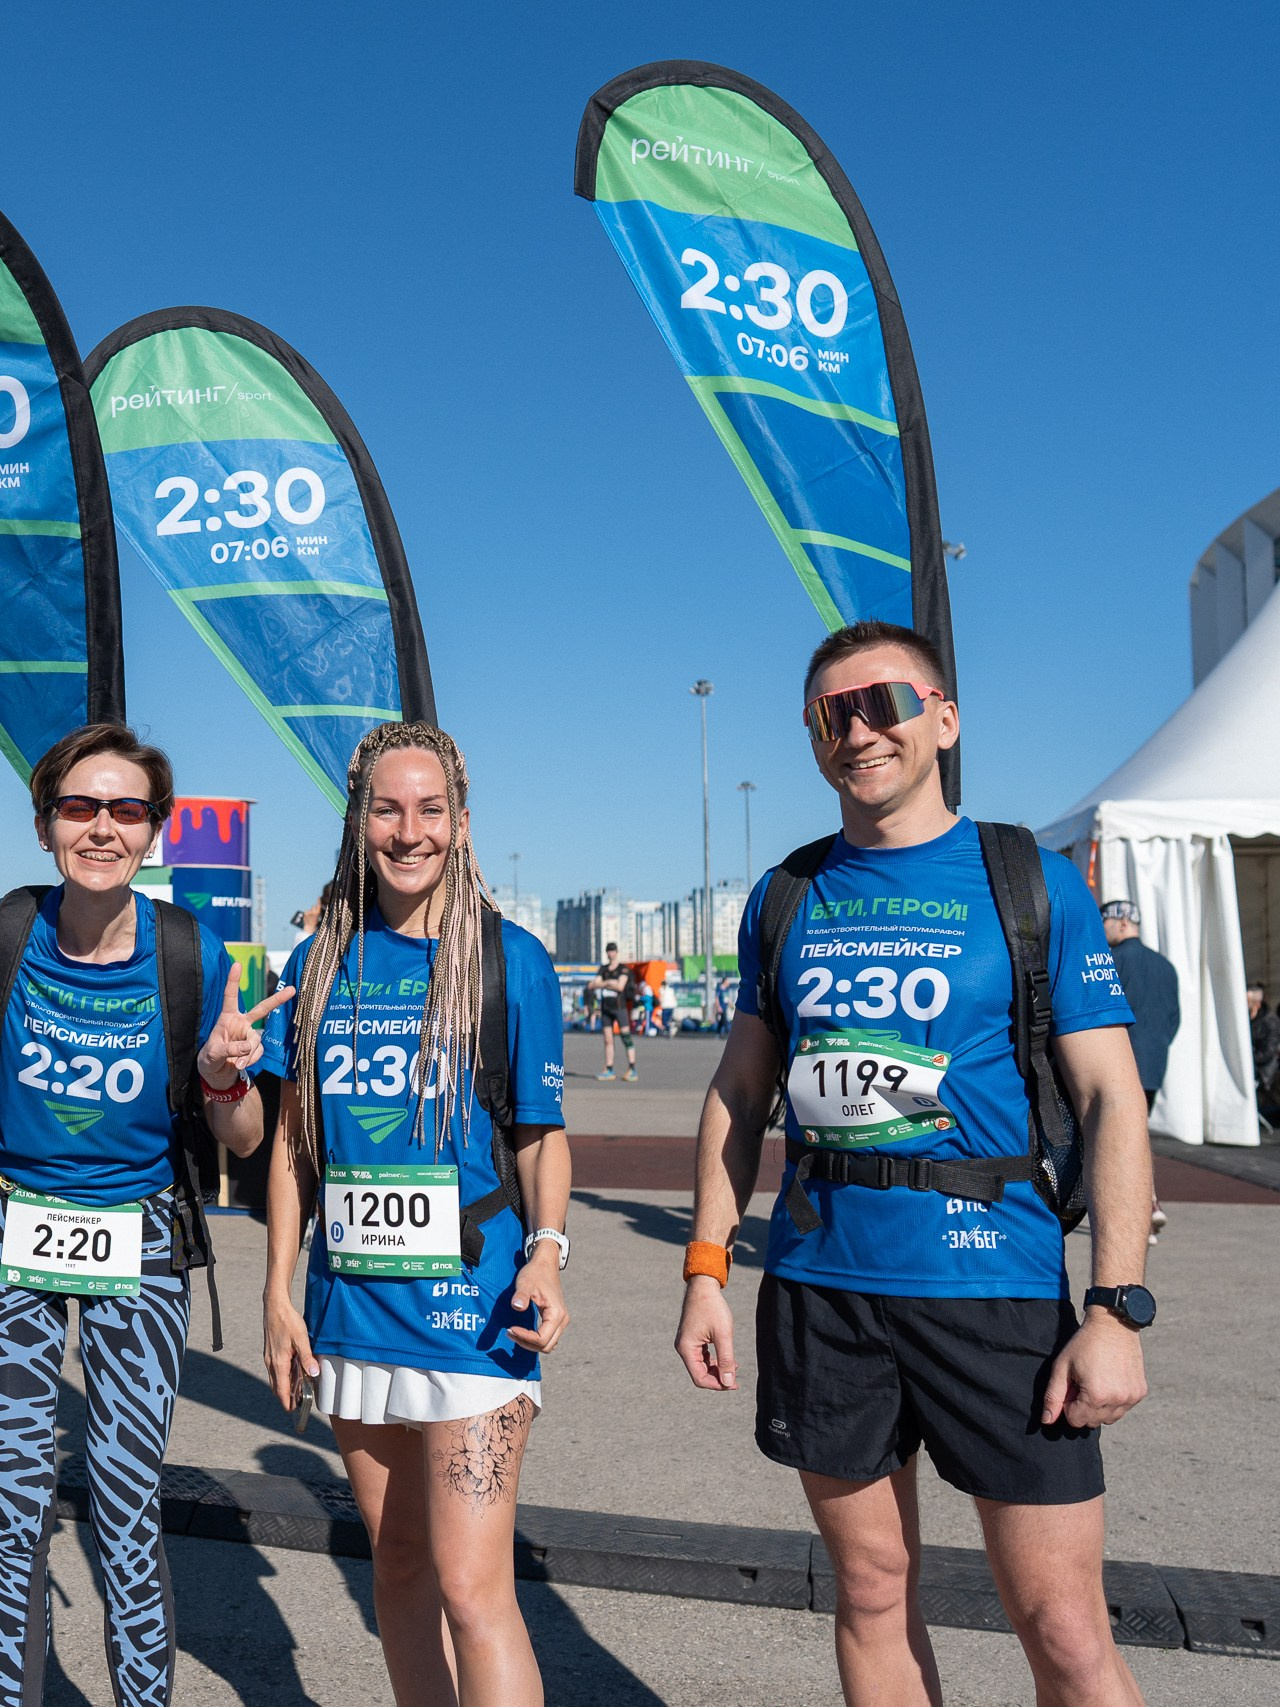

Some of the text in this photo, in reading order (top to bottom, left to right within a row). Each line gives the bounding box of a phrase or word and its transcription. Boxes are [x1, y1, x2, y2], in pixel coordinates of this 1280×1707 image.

[681, 247, 848, 337] 2:30
[737, 332, 809, 371] 07:06
[818, 349, 849, 363] мин
[818, 361, 840, 373] км
[154, 467, 326, 536] 2:30
[210, 536, 289, 564] 07:06
[296, 536, 328, 545] мин
[297, 547, 320, 556] км
[810, 897, 969, 921] БЕГИ, ГЕРОЙ!
[814, 925, 898, 935] БЛАГОТВОРИТЕЛЬНЫЙ
[899, 925, 965, 936] ПОЛУМАРАФОН
[800, 937, 963, 959] ПЕЙСМЕЙКЕР
[796, 966, 950, 1021] 2:30
[24, 1013, 149, 1050] ПЕЙСМЕЙКЕР
[18, 1041, 144, 1103] 2:20
[322, 1044, 451, 1099] 2:30
[812, 1059, 909, 1098] 1199
[842, 1102, 876, 1117] ОЛЕГ
[46, 1213, 102, 1225] ПЕЙСМЕЙКЕР
[343, 1191, 430, 1228] 1200
[32, 1223, 112, 1262] 2:20
[361, 1234, 406, 1246] ИРИНА
[451, 1284, 480, 1297] ПСБ
